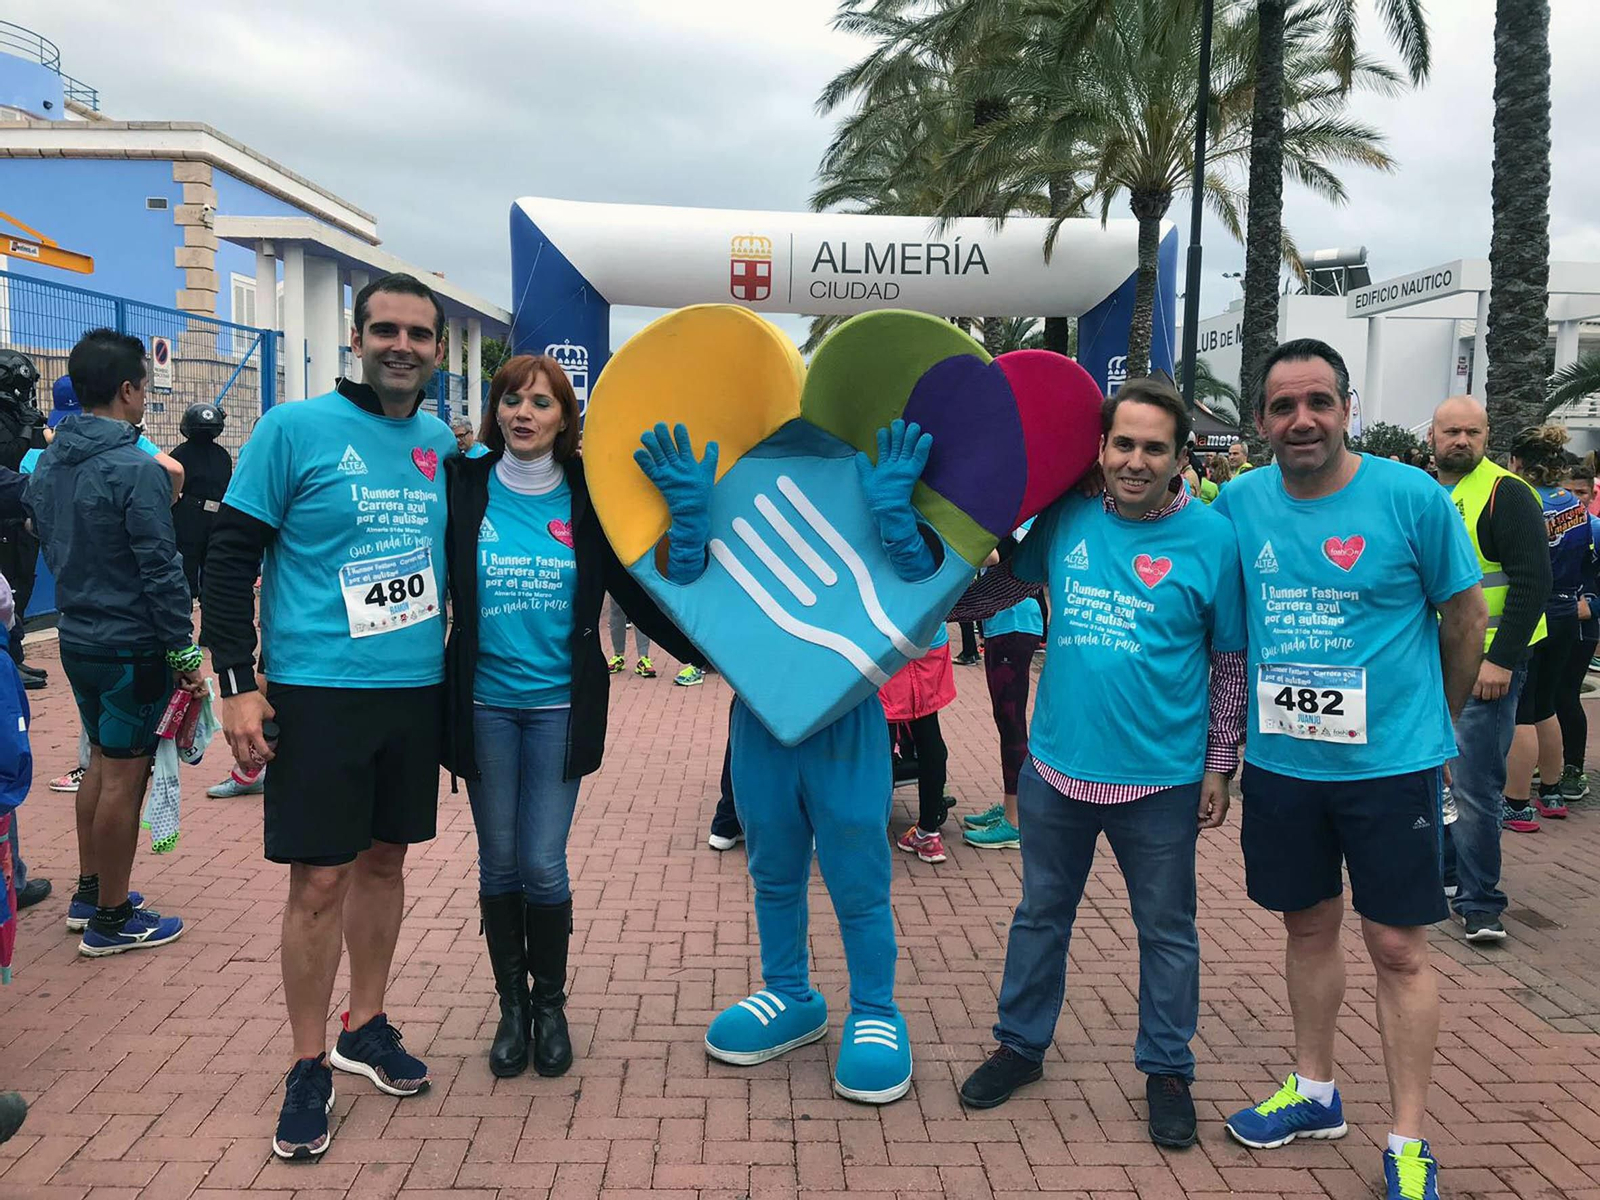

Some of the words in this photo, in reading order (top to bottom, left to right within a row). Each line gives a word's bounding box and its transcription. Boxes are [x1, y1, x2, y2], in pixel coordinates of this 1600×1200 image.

[811, 236, 989, 275] ALMERÍA
[810, 281, 900, 300] CIUDAD
[1356, 285, 1399, 309] EDIFICIO
[1401, 270, 1452, 297] NAUTICO
[1220, 330, 1233, 347] DE
[337, 461, 367, 471] ALTEA
[350, 483, 358, 501] I
[361, 487, 400, 500] Runner
[403, 488, 438, 502] Fashion
[358, 500, 404, 512] Carrera
[407, 502, 426, 513] azul
[356, 514, 375, 525] por
[378, 513, 389, 525] el
[392, 512, 429, 525] autismo
[349, 544, 374, 559] Que
[375, 535, 402, 553] nada
[401, 533, 414, 546] te
[481, 549, 487, 566] I
[490, 553, 532, 565] Runner
[535, 556, 577, 569] Fashion
[1063, 555, 1089, 565] ALTEA
[1254, 559, 1278, 569] ALTEA
[486, 566, 535, 577] Carrera
[538, 569, 560, 580] azul
[364, 573, 425, 607] 480
[485, 579, 503, 588] por
[506, 578, 518, 589] el
[521, 578, 563, 590] autismo
[1261, 582, 1267, 600] I
[1269, 586, 1308, 599] Runner
[1311, 586, 1359, 600] Fashion
[1064, 576, 1071, 592] I
[1072, 580, 1111, 598] Runner
[1113, 591, 1155, 612] Fashion
[480, 606, 501, 618] Que
[503, 598, 529, 614] nada
[529, 597, 542, 609] te
[544, 599, 569, 612] pare
[1067, 594, 1112, 613] Carrera
[1114, 605, 1135, 620] azul
[1266, 600, 1312, 612] Carrera
[1316, 601, 1340, 614] azul
[1064, 607, 1079, 616] por
[1081, 609, 1092, 620] el
[1095, 613, 1137, 630] autismo
[1265, 614, 1281, 625] por
[1283, 613, 1295, 626] el
[1298, 613, 1345, 626] autismo
[1058, 635, 1073, 647] Que
[1074, 631, 1099, 646] nada
[1100, 632, 1114, 646] te
[1114, 637, 1142, 653] pare
[1261, 646, 1279, 659] Que
[1281, 636, 1306, 654] nada
[1307, 634, 1321, 649] te
[1324, 637, 1355, 653] pare
[1274, 686, 1344, 716] 482
[1297, 714, 1322, 725] JUANJO
